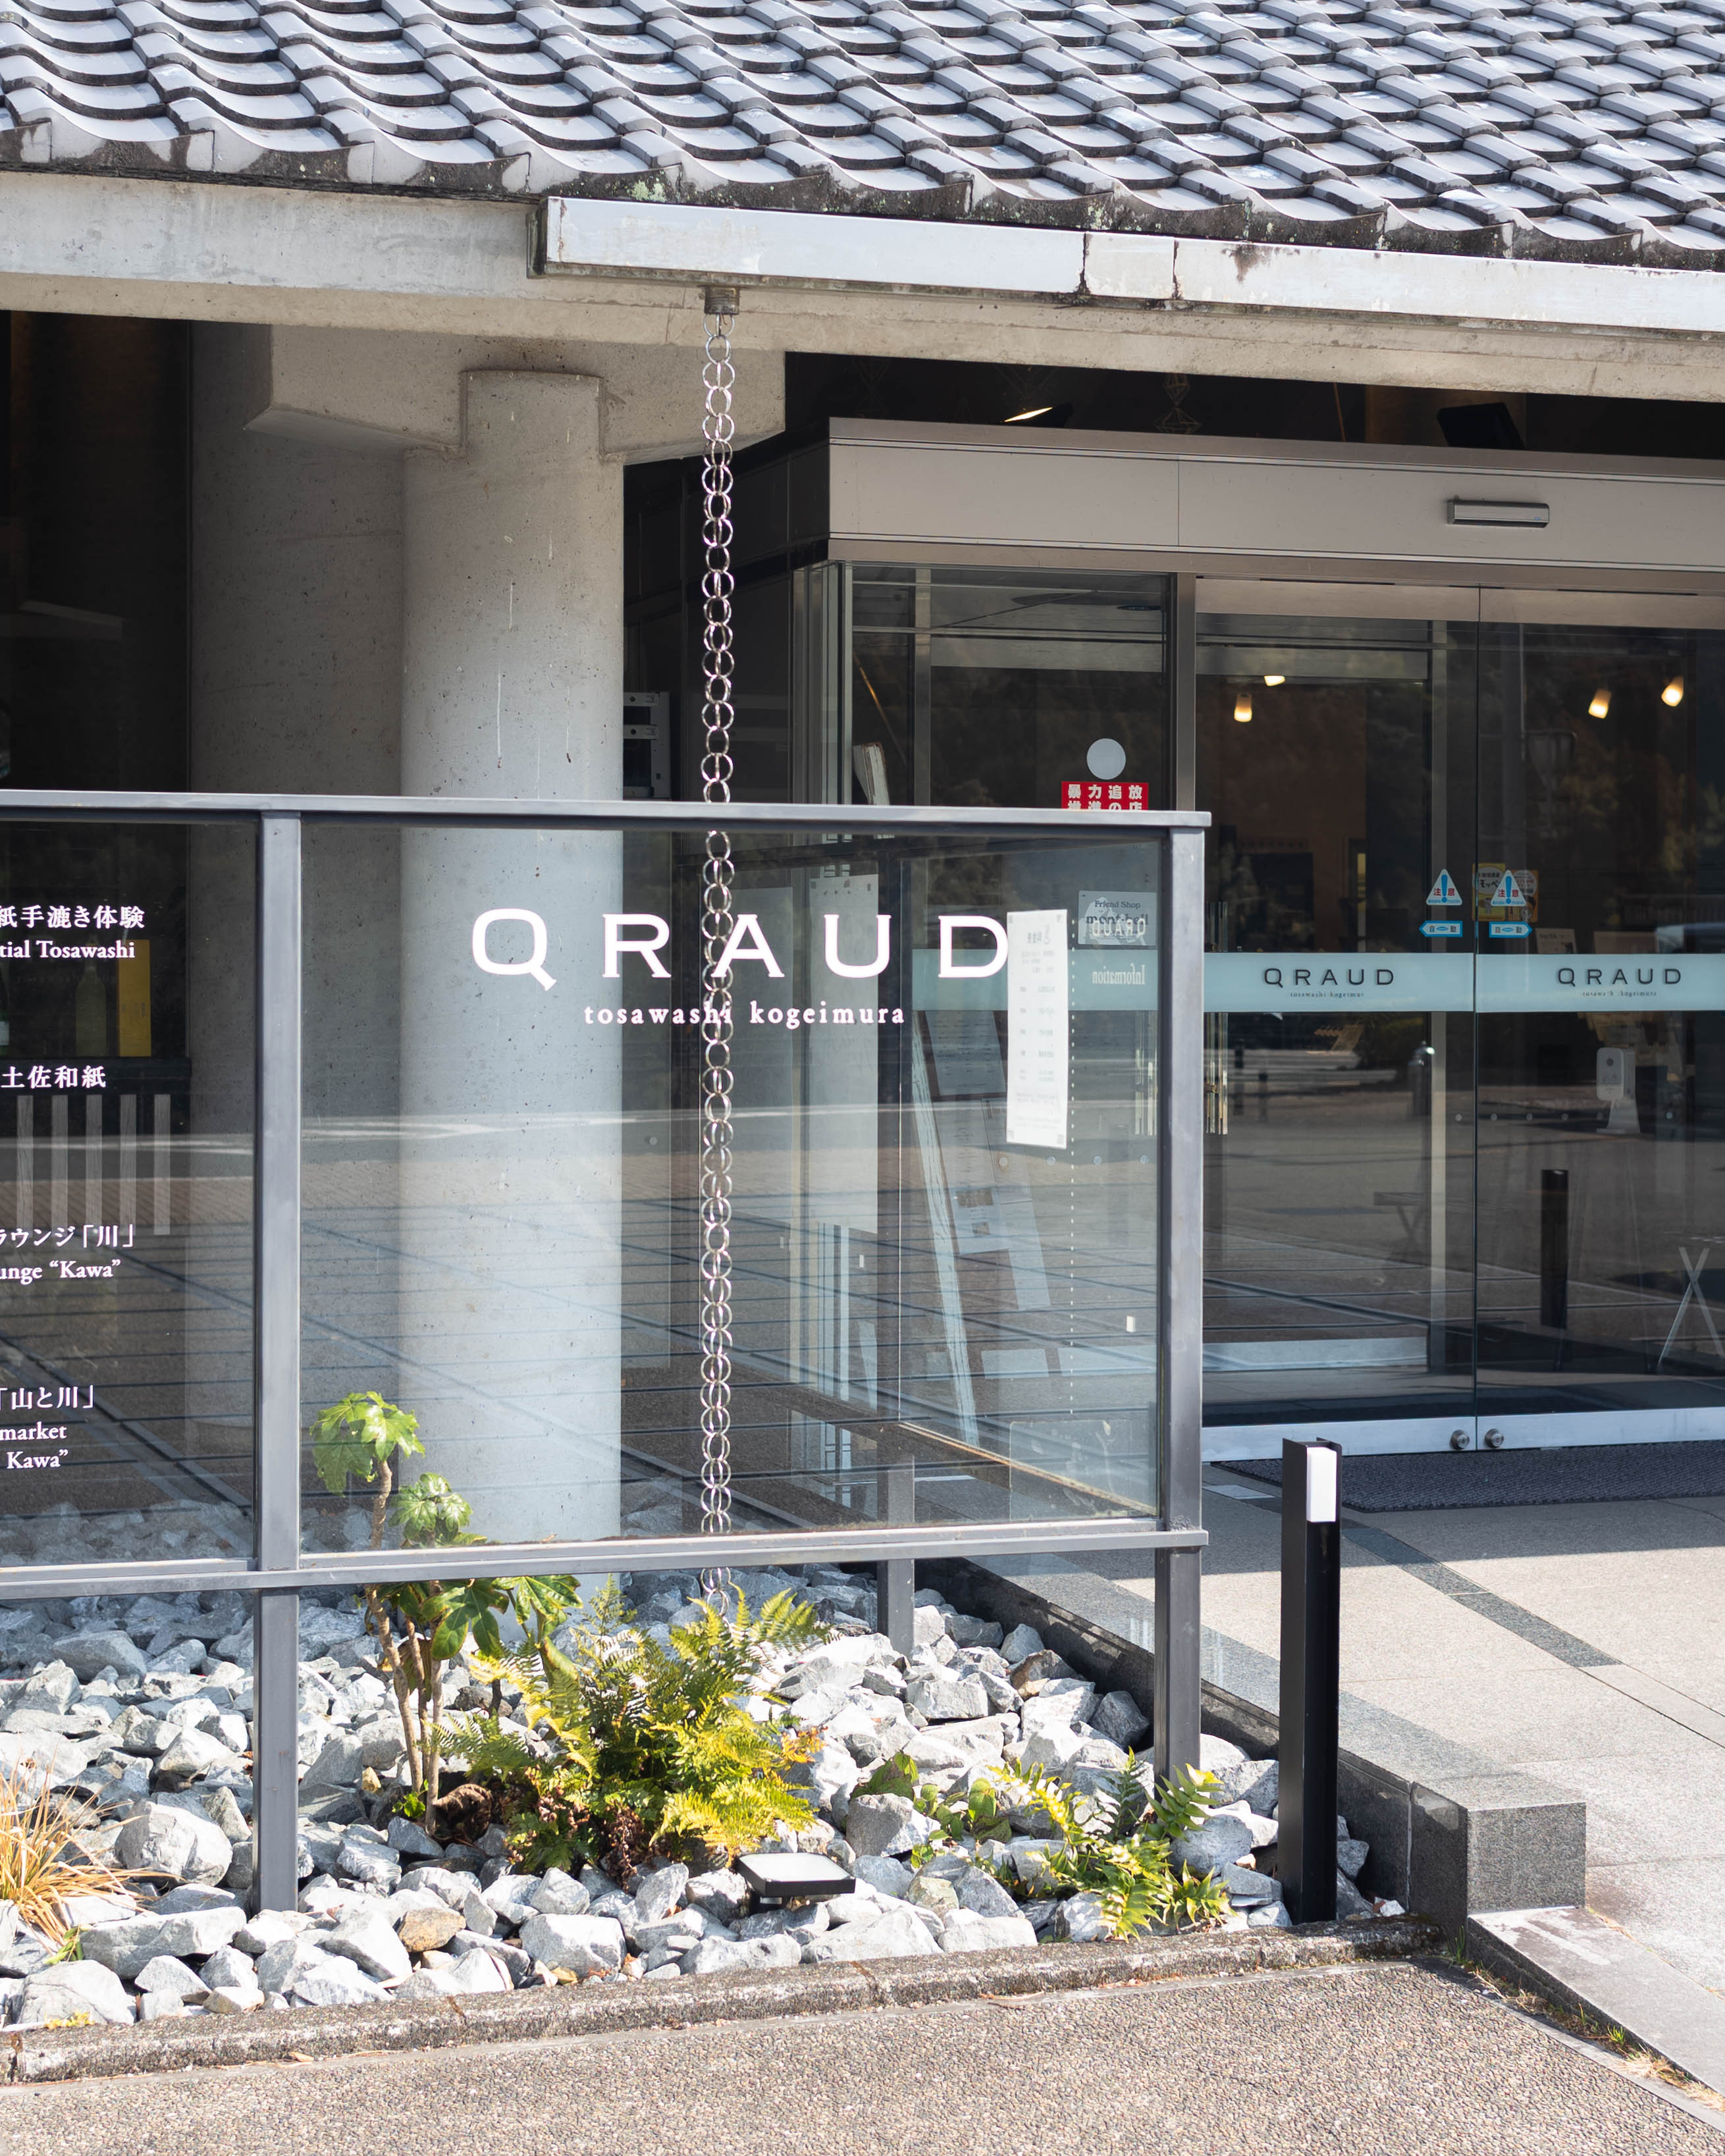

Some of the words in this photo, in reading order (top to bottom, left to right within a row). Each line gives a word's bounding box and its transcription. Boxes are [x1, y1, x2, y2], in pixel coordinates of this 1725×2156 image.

[1068, 784, 1142, 799] 暴力追放
[36, 939, 135, 959] Tosawashi
[472, 908, 1009, 991] QRAUD
[1263, 968, 1394, 988] QRAUD
[1557, 968, 1682, 987] QRAUD
[585, 1001, 731, 1024] tosawashi
[749, 1001, 904, 1030] kogeimura
[1, 1065, 106, 1088] 土佐和紙
[0, 1421, 67, 1441] market
[7, 1449, 68, 1469] Kawa”
